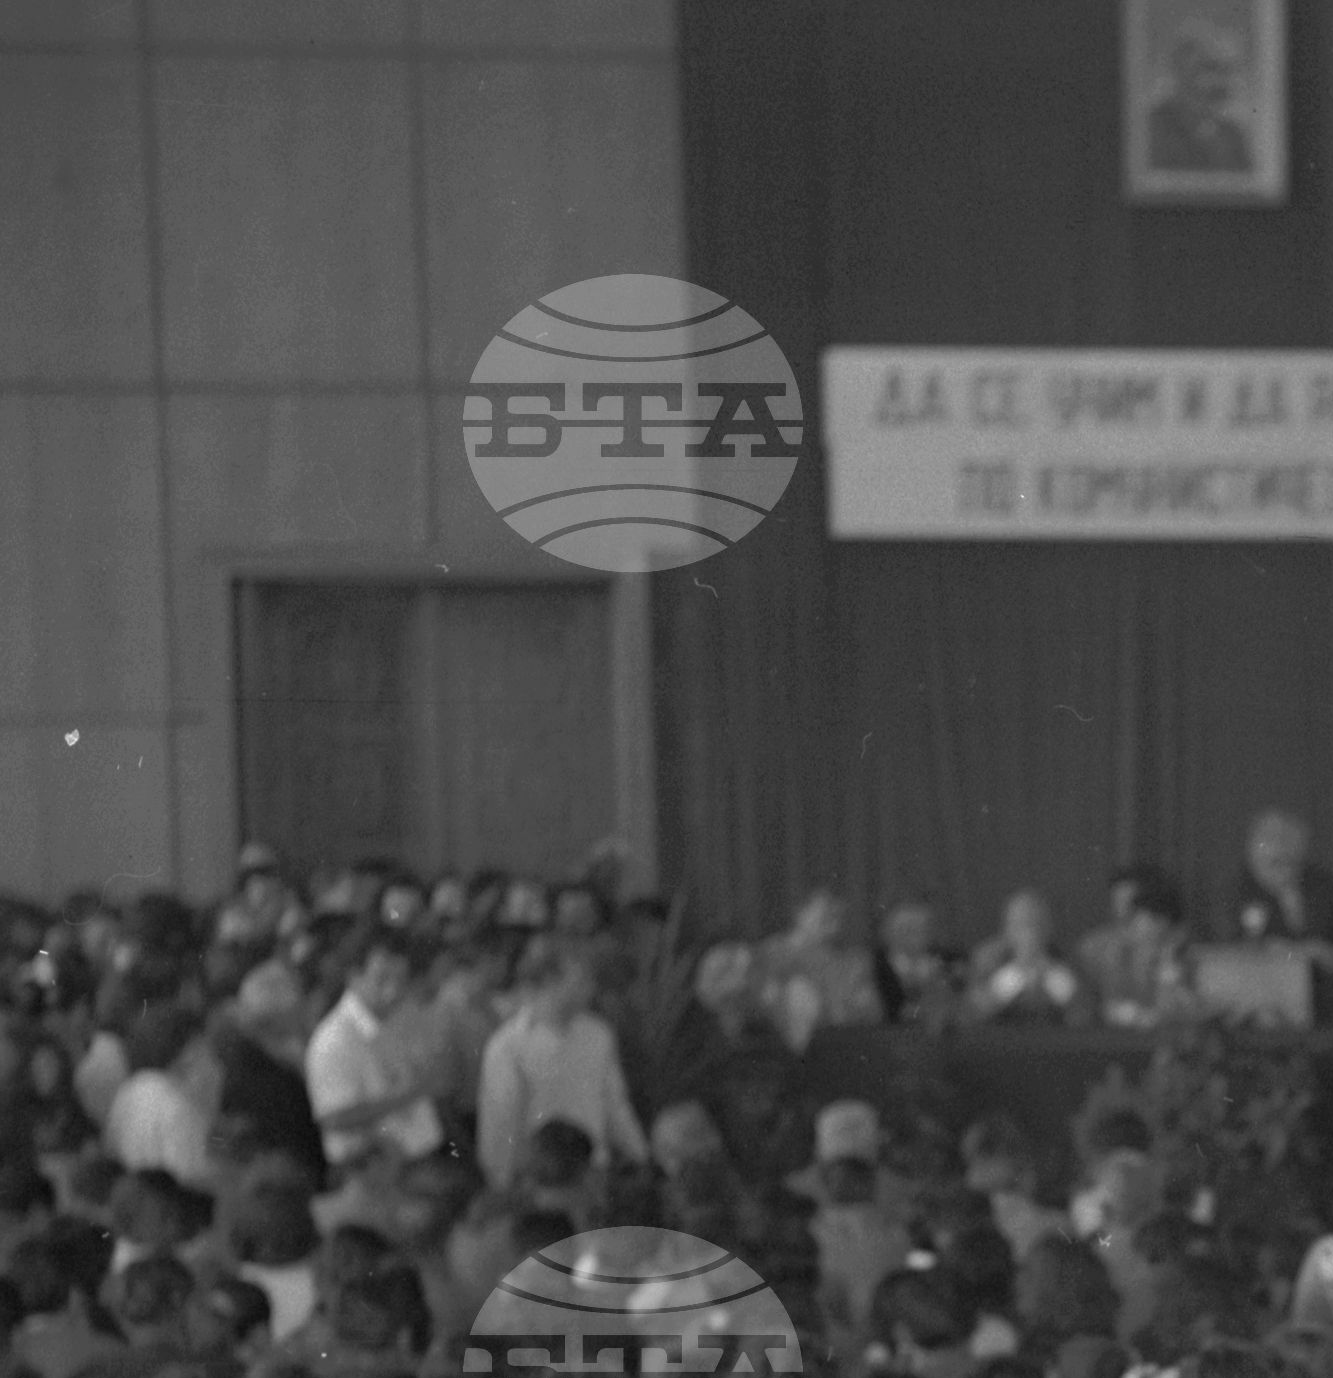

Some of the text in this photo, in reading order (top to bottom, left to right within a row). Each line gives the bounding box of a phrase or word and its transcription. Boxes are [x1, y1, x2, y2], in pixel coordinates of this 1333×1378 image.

[873, 366, 947, 427] ДА
[969, 371, 1023, 427] СЕ
[1181, 375, 1207, 424] И
[1227, 376, 1288, 430] ДА
[957, 462, 1015, 514] ПО
